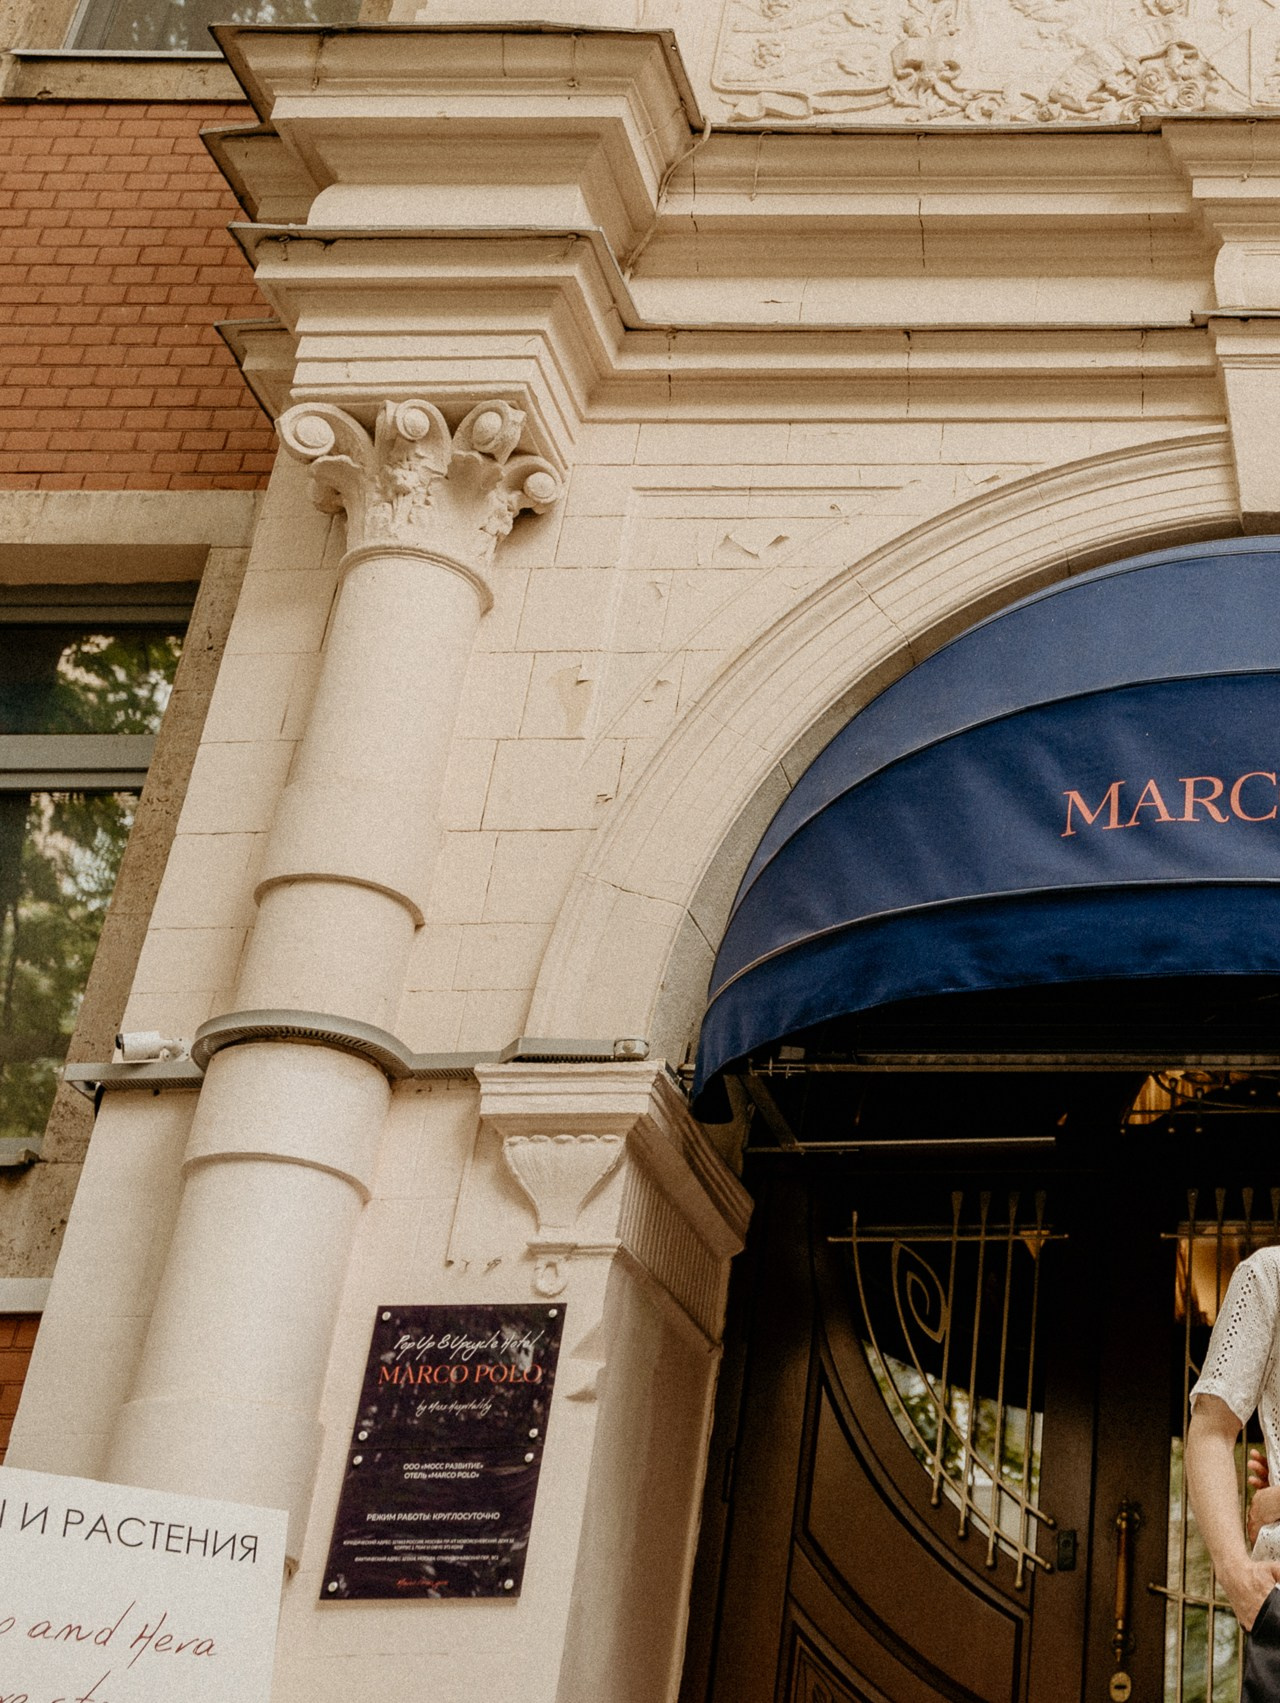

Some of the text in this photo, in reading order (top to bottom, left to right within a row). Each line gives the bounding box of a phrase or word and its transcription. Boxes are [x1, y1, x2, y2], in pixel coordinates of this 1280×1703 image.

[449, 1330, 499, 1361] Upcycle
[501, 1330, 545, 1354] Hotel
[378, 1364, 543, 1385] MARCO POLO
[415, 1400, 427, 1417] by
[366, 1511, 500, 1521] РЕЖИМ РАБОТЫ: КРУГЛОСУТОЧНО
[20, 1502, 49, 1534] И
[63, 1508, 259, 1563] РАСТЕНИЯ
[27, 1600, 216, 1669] and Hera
